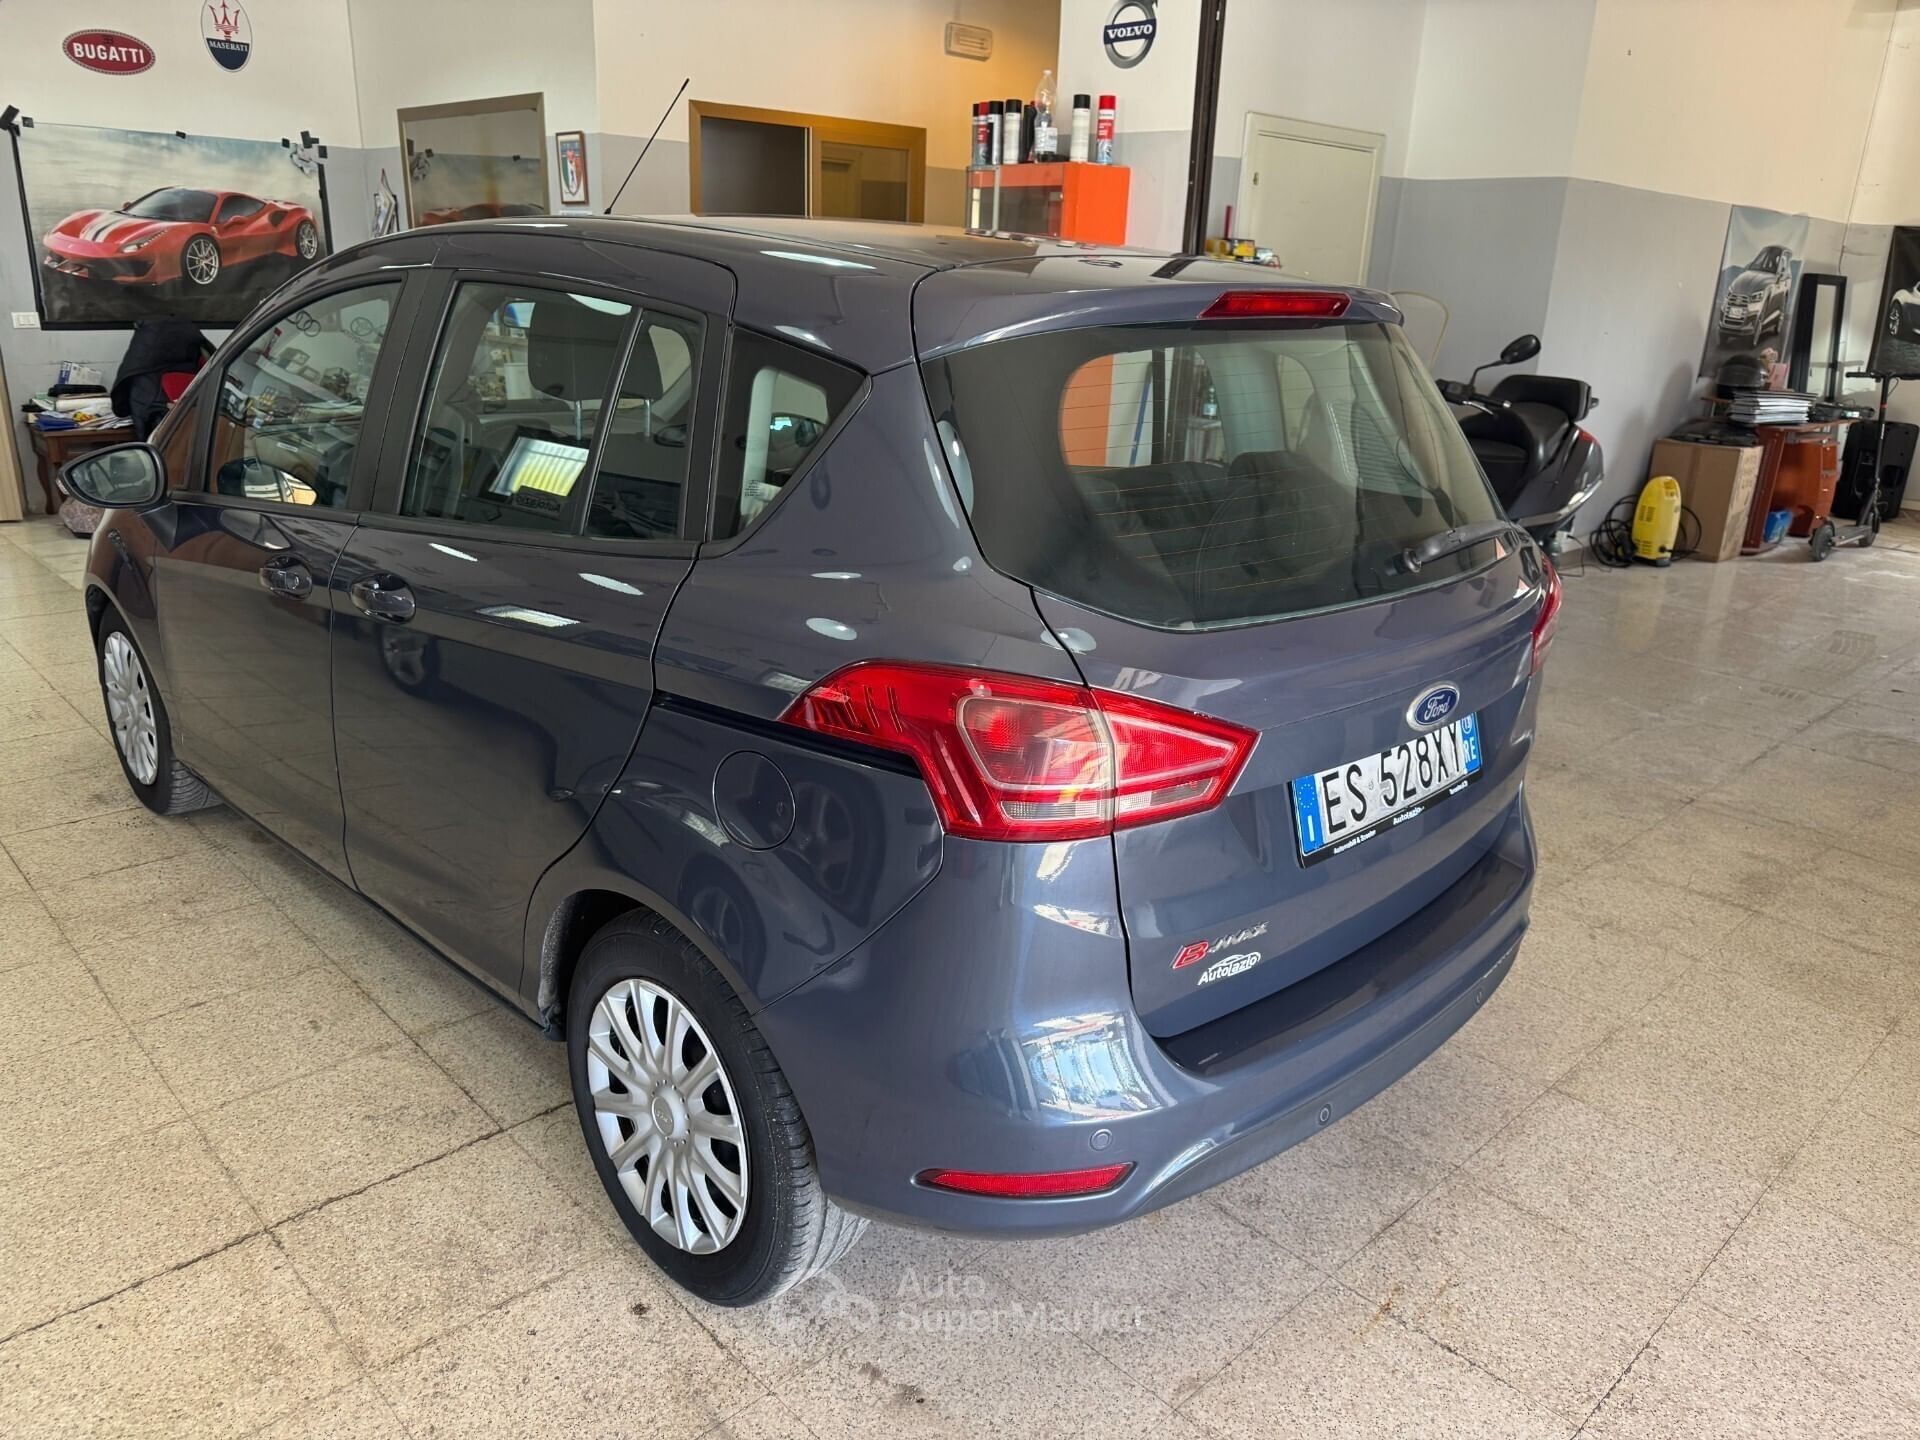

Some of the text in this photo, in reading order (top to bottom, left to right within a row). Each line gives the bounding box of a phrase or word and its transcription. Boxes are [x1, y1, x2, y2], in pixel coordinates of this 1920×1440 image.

[1107, 24, 1153, 39] VOLVO
[72, 42, 145, 64] BUGATTI
[209, 40, 249, 52] MASERATI
[1424, 694, 1451, 721] Ford
[1463, 736, 1477, 764] RE
[1322, 720, 1460, 834] ES 528XY
[1308, 815, 1315, 842] I
